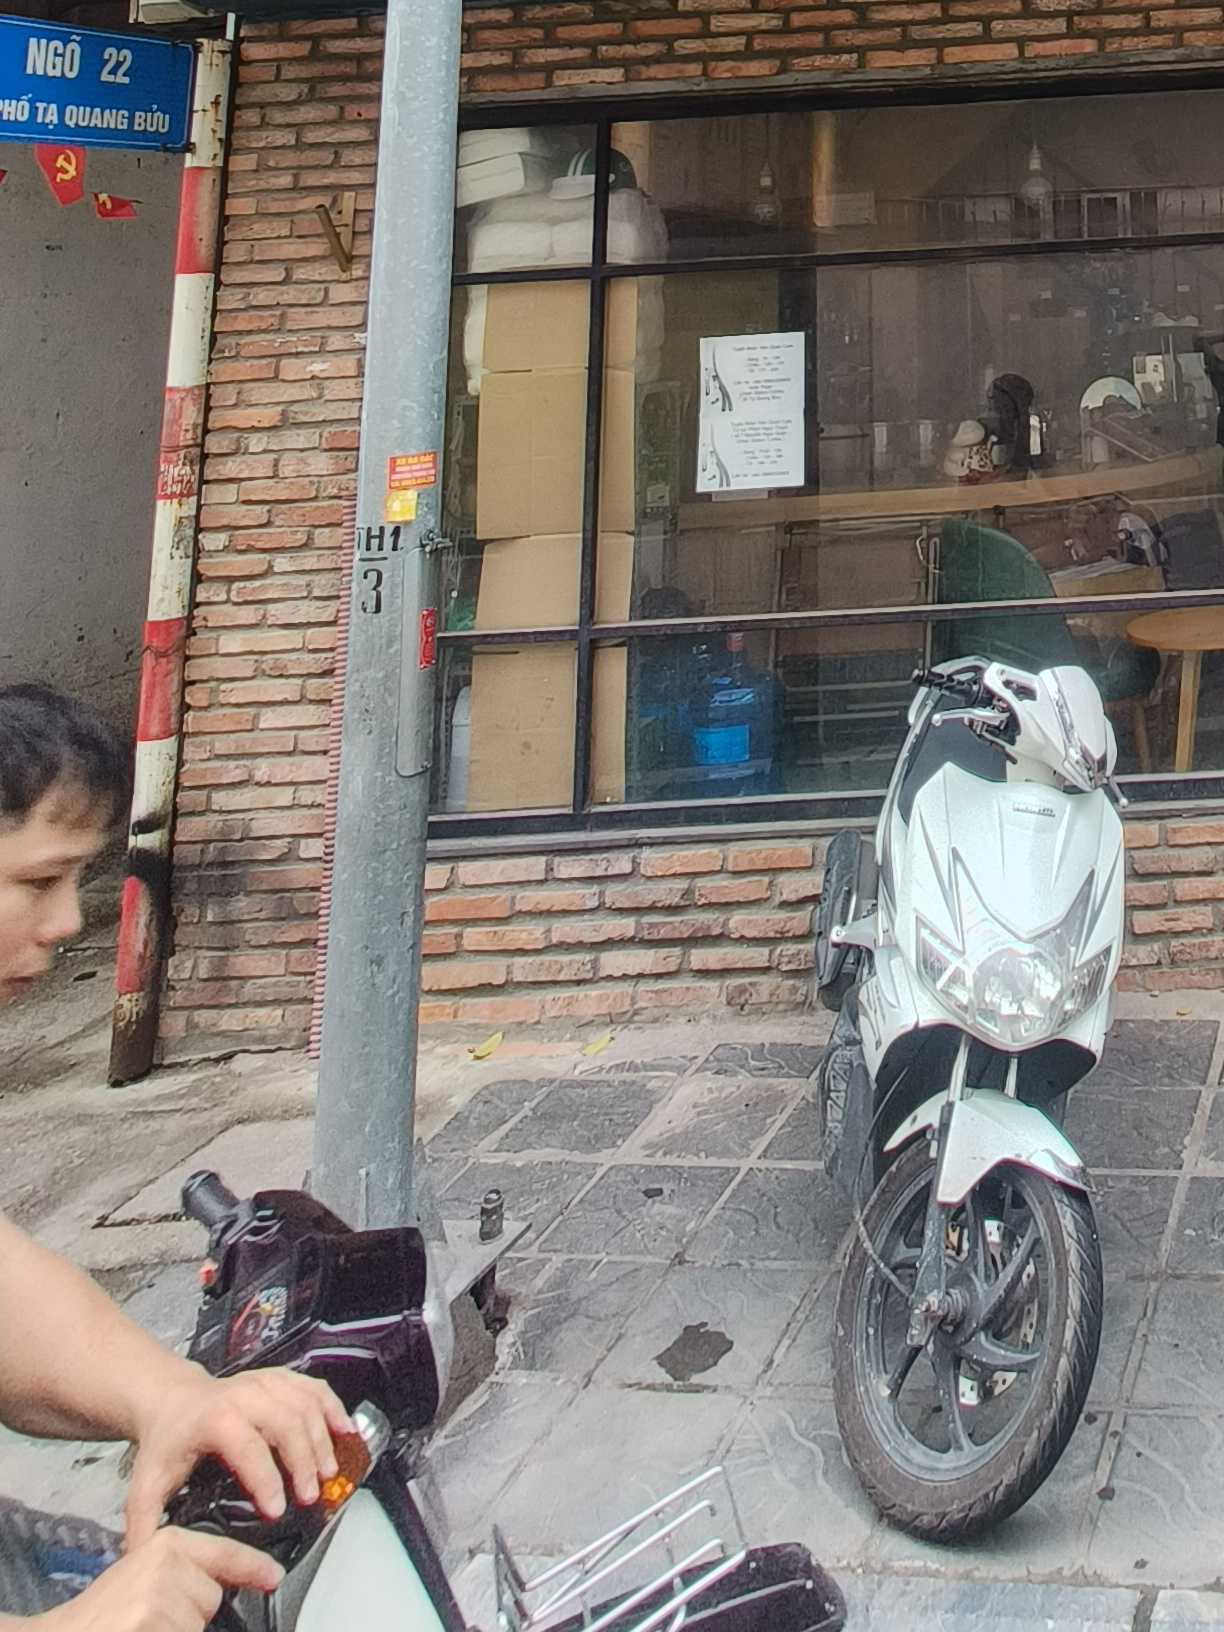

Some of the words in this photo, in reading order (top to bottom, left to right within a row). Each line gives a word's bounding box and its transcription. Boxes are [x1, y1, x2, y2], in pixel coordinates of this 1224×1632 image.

[25, 35, 82, 79] NGÕ
[100, 47, 133, 85] 22
[35, 101, 59, 130] TẠ
[64, 105, 129, 130] QUANG
[134, 104, 170, 133] BỬU
[361, 568, 384, 615] 3
